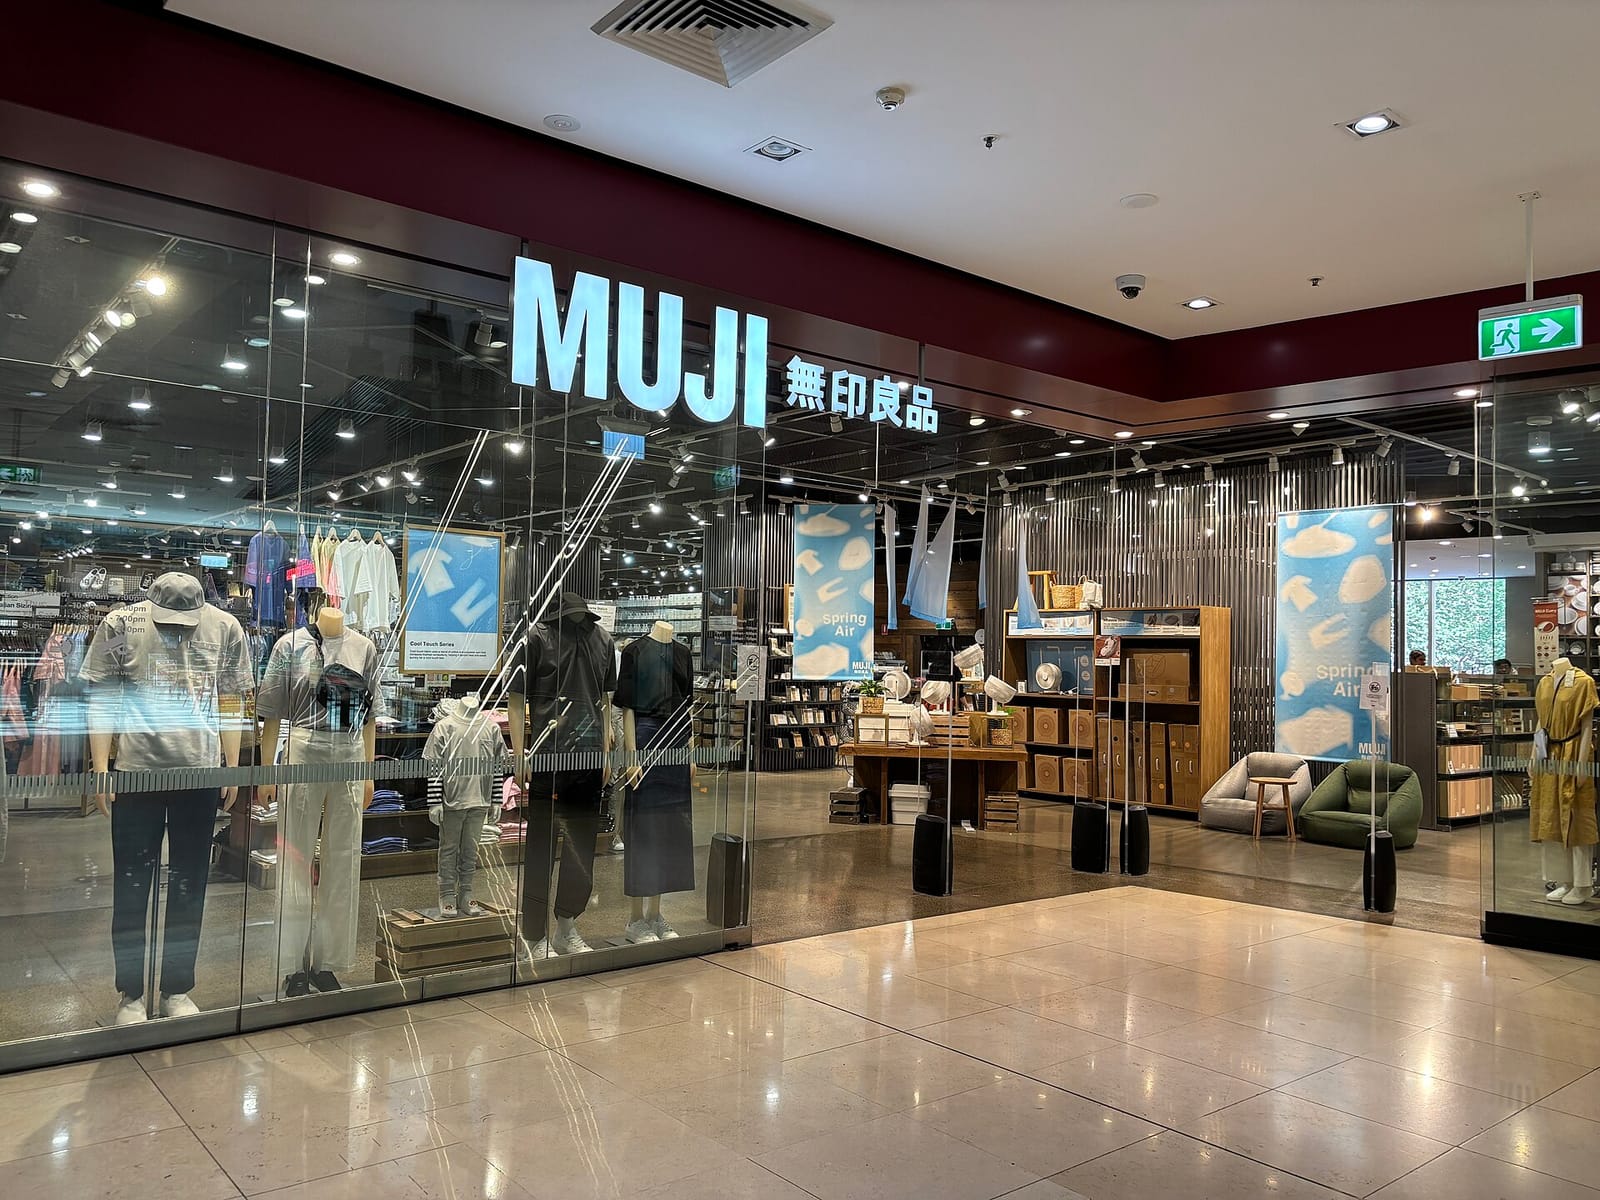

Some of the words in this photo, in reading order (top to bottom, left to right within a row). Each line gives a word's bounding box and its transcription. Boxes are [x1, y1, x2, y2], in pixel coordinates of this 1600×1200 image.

[511, 255, 769, 428] MUJI
[786, 355, 939, 434] 無印良品
[115, 614, 146, 623] 7:00pm
[823, 612, 867, 627] Spring
[22, 621, 42, 630] Sun:
[834, 626, 855, 638] Air
[852, 661, 871, 670] MUJI
[1333, 680, 1360, 698] Air
